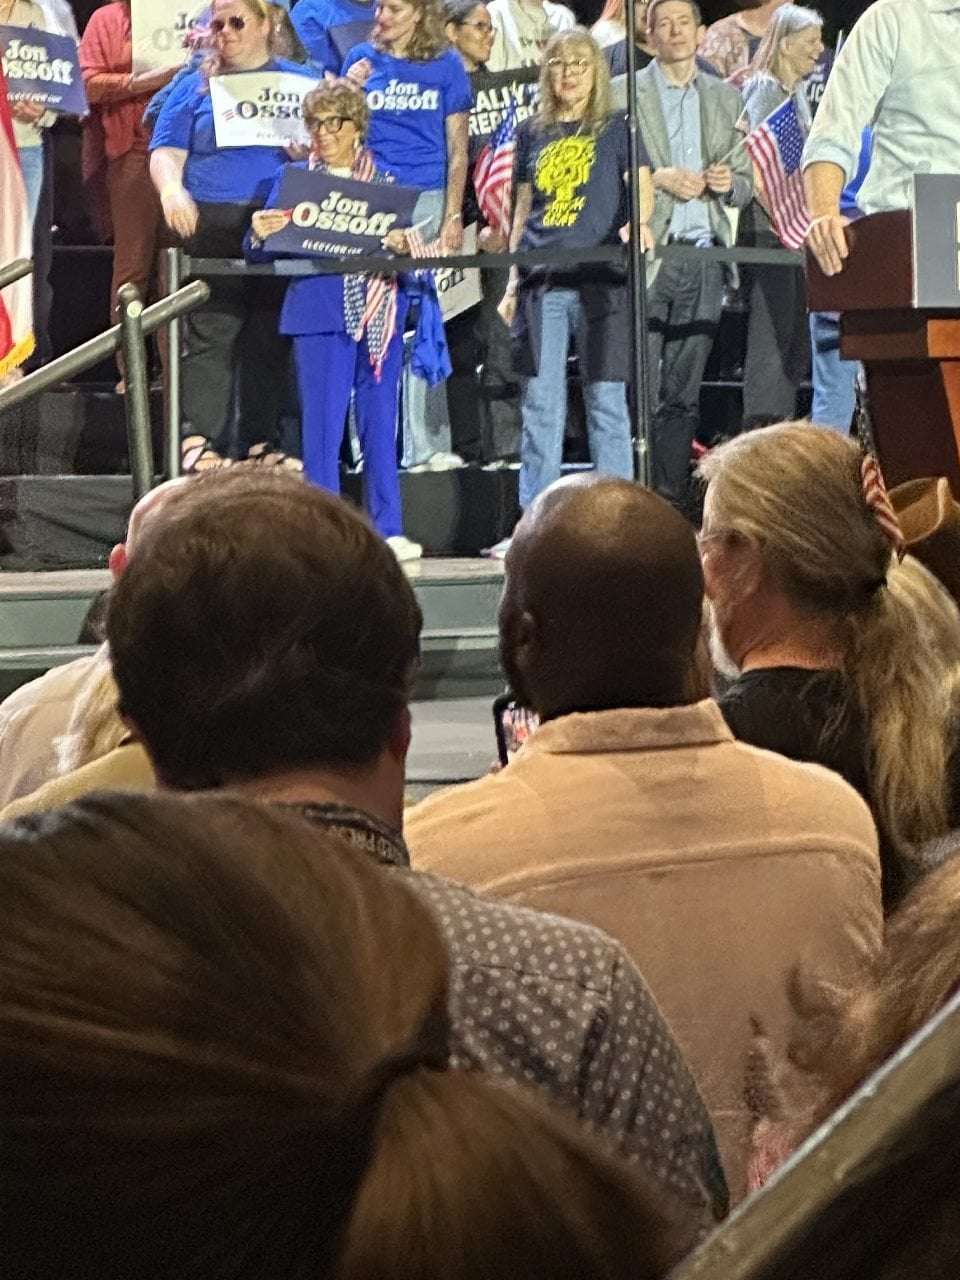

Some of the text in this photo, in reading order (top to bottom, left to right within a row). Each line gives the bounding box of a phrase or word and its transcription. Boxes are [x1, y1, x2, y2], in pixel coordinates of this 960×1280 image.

[5, 39, 49, 62] Jon
[1, 57, 74, 86] ssoff
[257, 87, 301, 103] Jon
[385, 79, 420, 96] Jon
[367, 89, 440, 110] Ossoff
[321, 190, 369, 216] Jon
[292, 201, 397, 236] Ossoff
